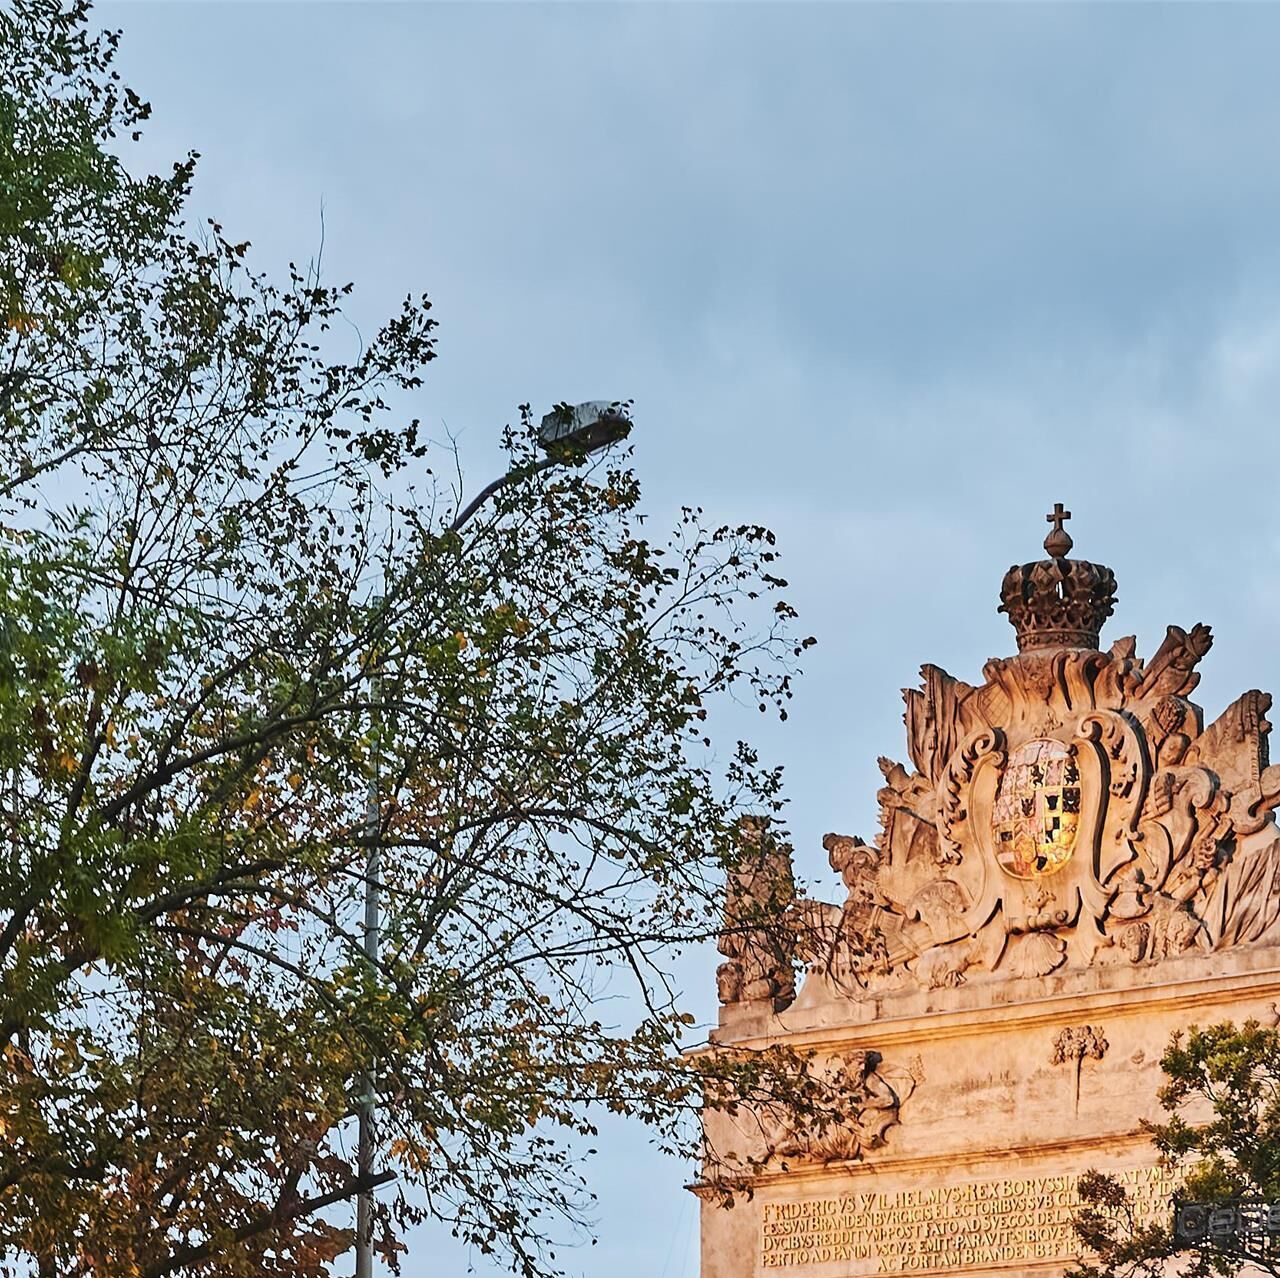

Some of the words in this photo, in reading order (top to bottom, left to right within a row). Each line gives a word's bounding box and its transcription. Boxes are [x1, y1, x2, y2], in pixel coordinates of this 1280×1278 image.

[763, 1195, 855, 1222] FRIDERICVS
[763, 1219, 809, 1237] CESSVM
[763, 1232, 814, 1252] DVCIBVS
[984, 1212, 1035, 1232] SVECOS
[762, 1250, 809, 1268] PERTIO
[811, 1248, 832, 1264] AD
[878, 1259, 898, 1273] AC
[900, 1250, 962, 1271] PORTAM
